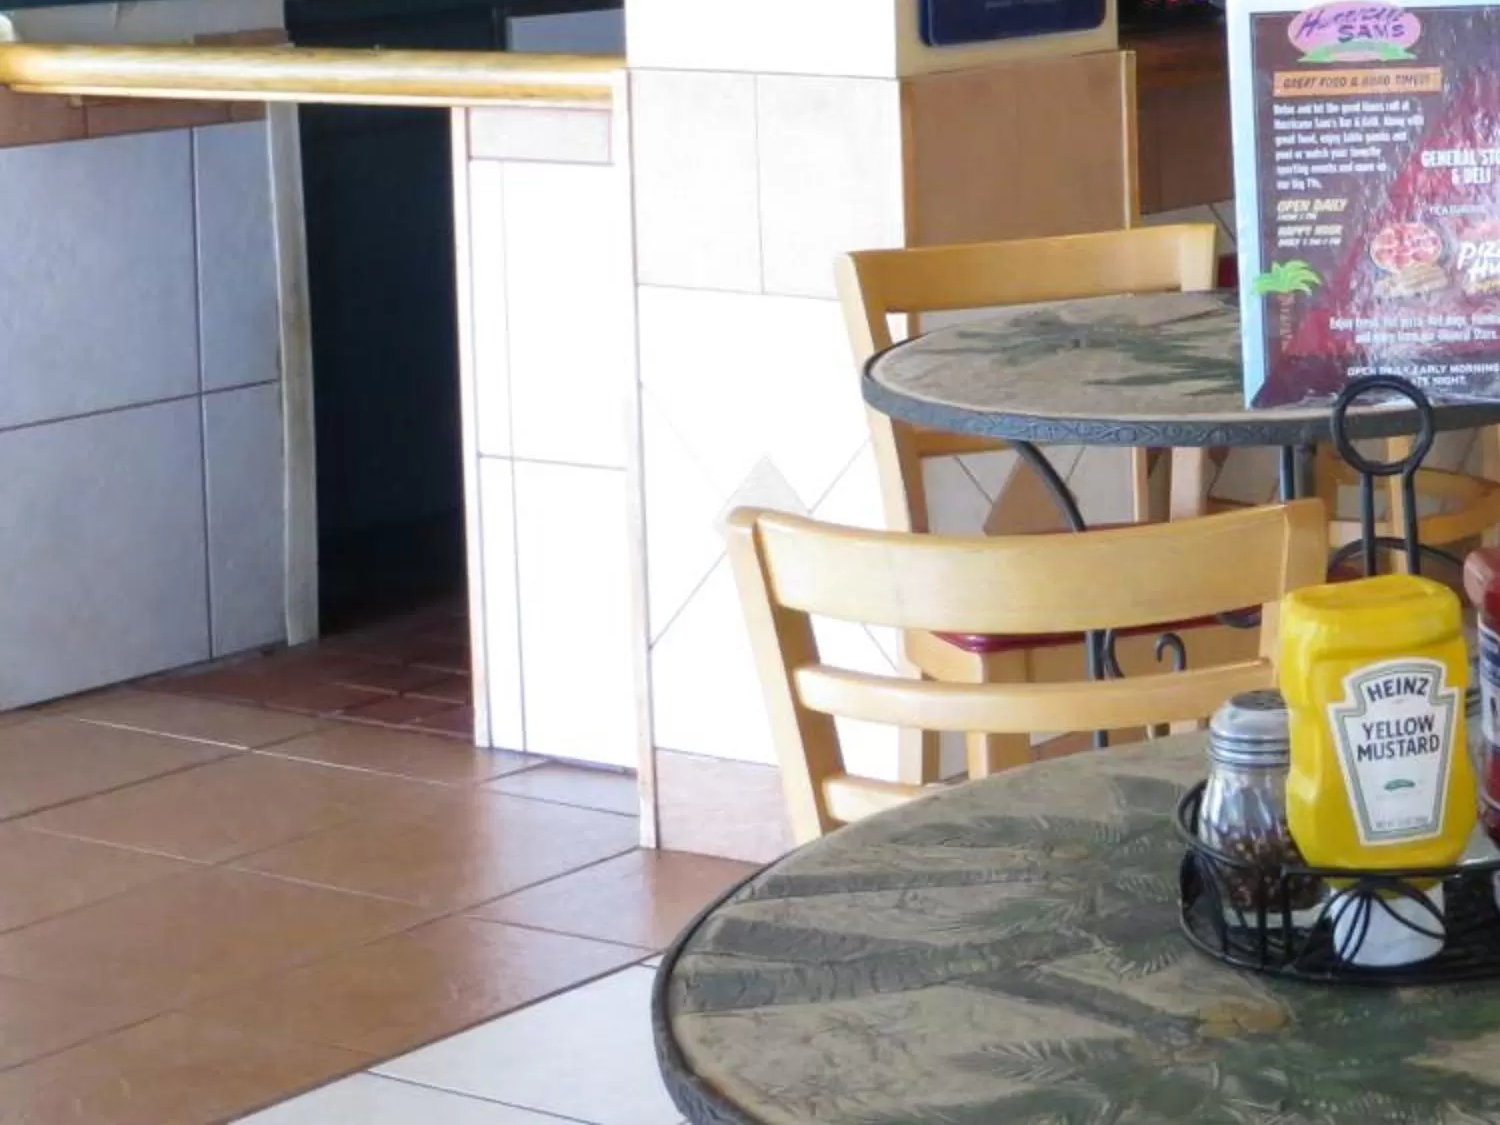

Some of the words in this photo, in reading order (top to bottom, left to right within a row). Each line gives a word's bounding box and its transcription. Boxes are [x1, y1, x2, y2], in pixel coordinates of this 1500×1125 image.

[1283, 75, 1317, 89] GREAT
[1319, 75, 1346, 88] FOOD
[1421, 150, 1476, 168] GENERAL
[1463, 166, 1491, 184] DELI
[1277, 198, 1311, 212] OPEN
[1314, 197, 1348, 212] DAILY
[1449, 362, 1500, 374] MORNING
[1366, 676, 1430, 702] HEINZ
[1361, 714, 1436, 741] YELLOW
[1357, 734, 1441, 763] MUSTARD
